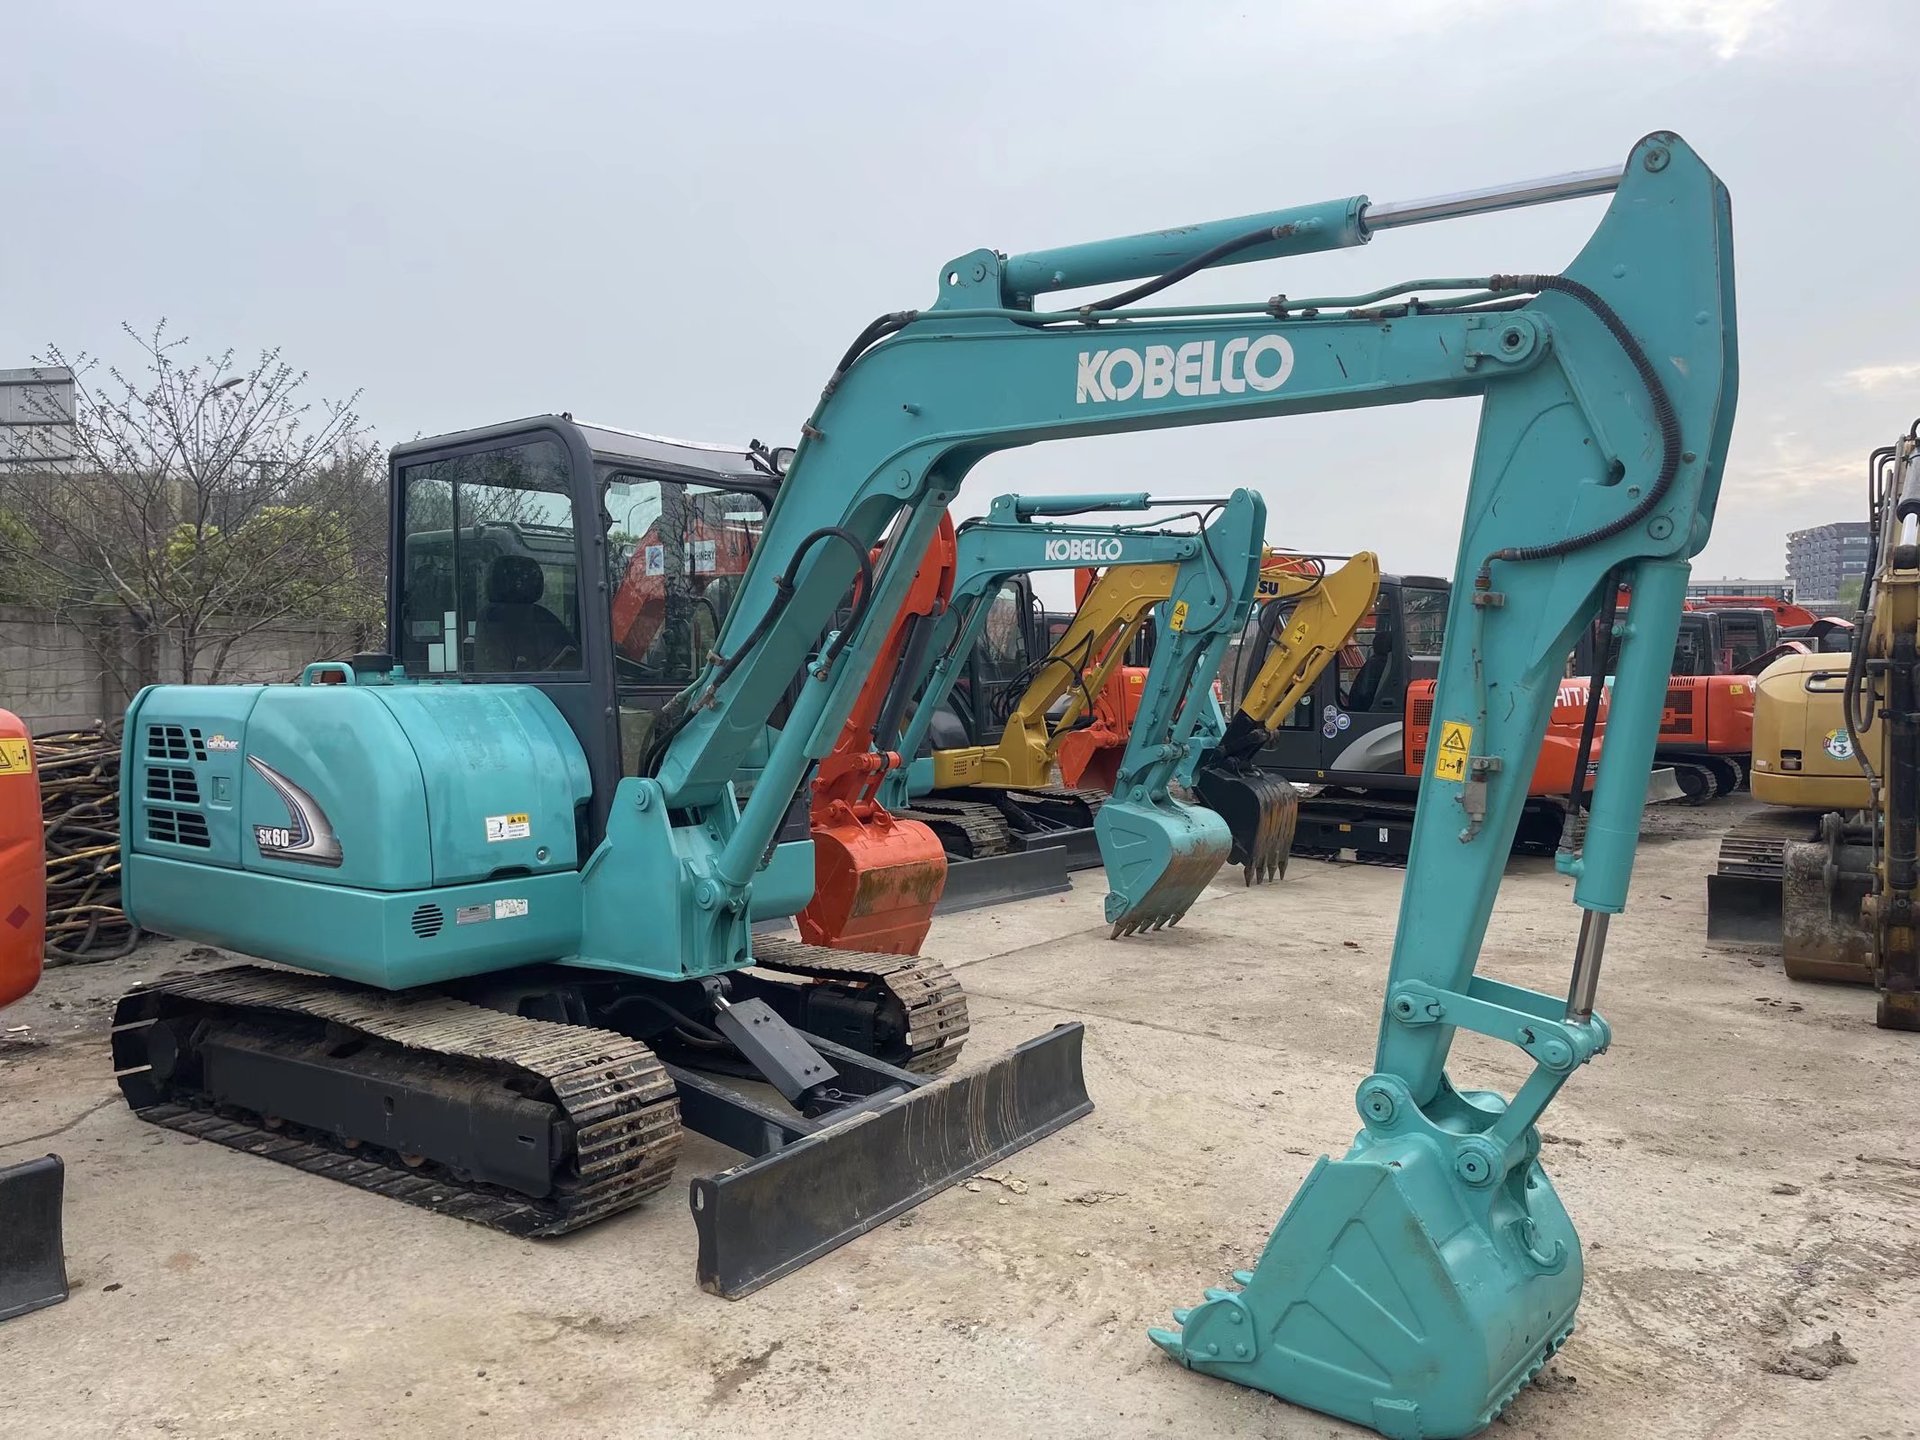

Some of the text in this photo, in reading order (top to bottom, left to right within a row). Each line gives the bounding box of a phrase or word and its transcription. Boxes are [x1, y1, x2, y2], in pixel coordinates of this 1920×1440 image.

[1076, 334, 1294, 404] KOBELCO
[1045, 538, 1122, 560] KOBELCO
[1257, 577, 1279, 595] SU
[259, 829, 289, 847] SK60
